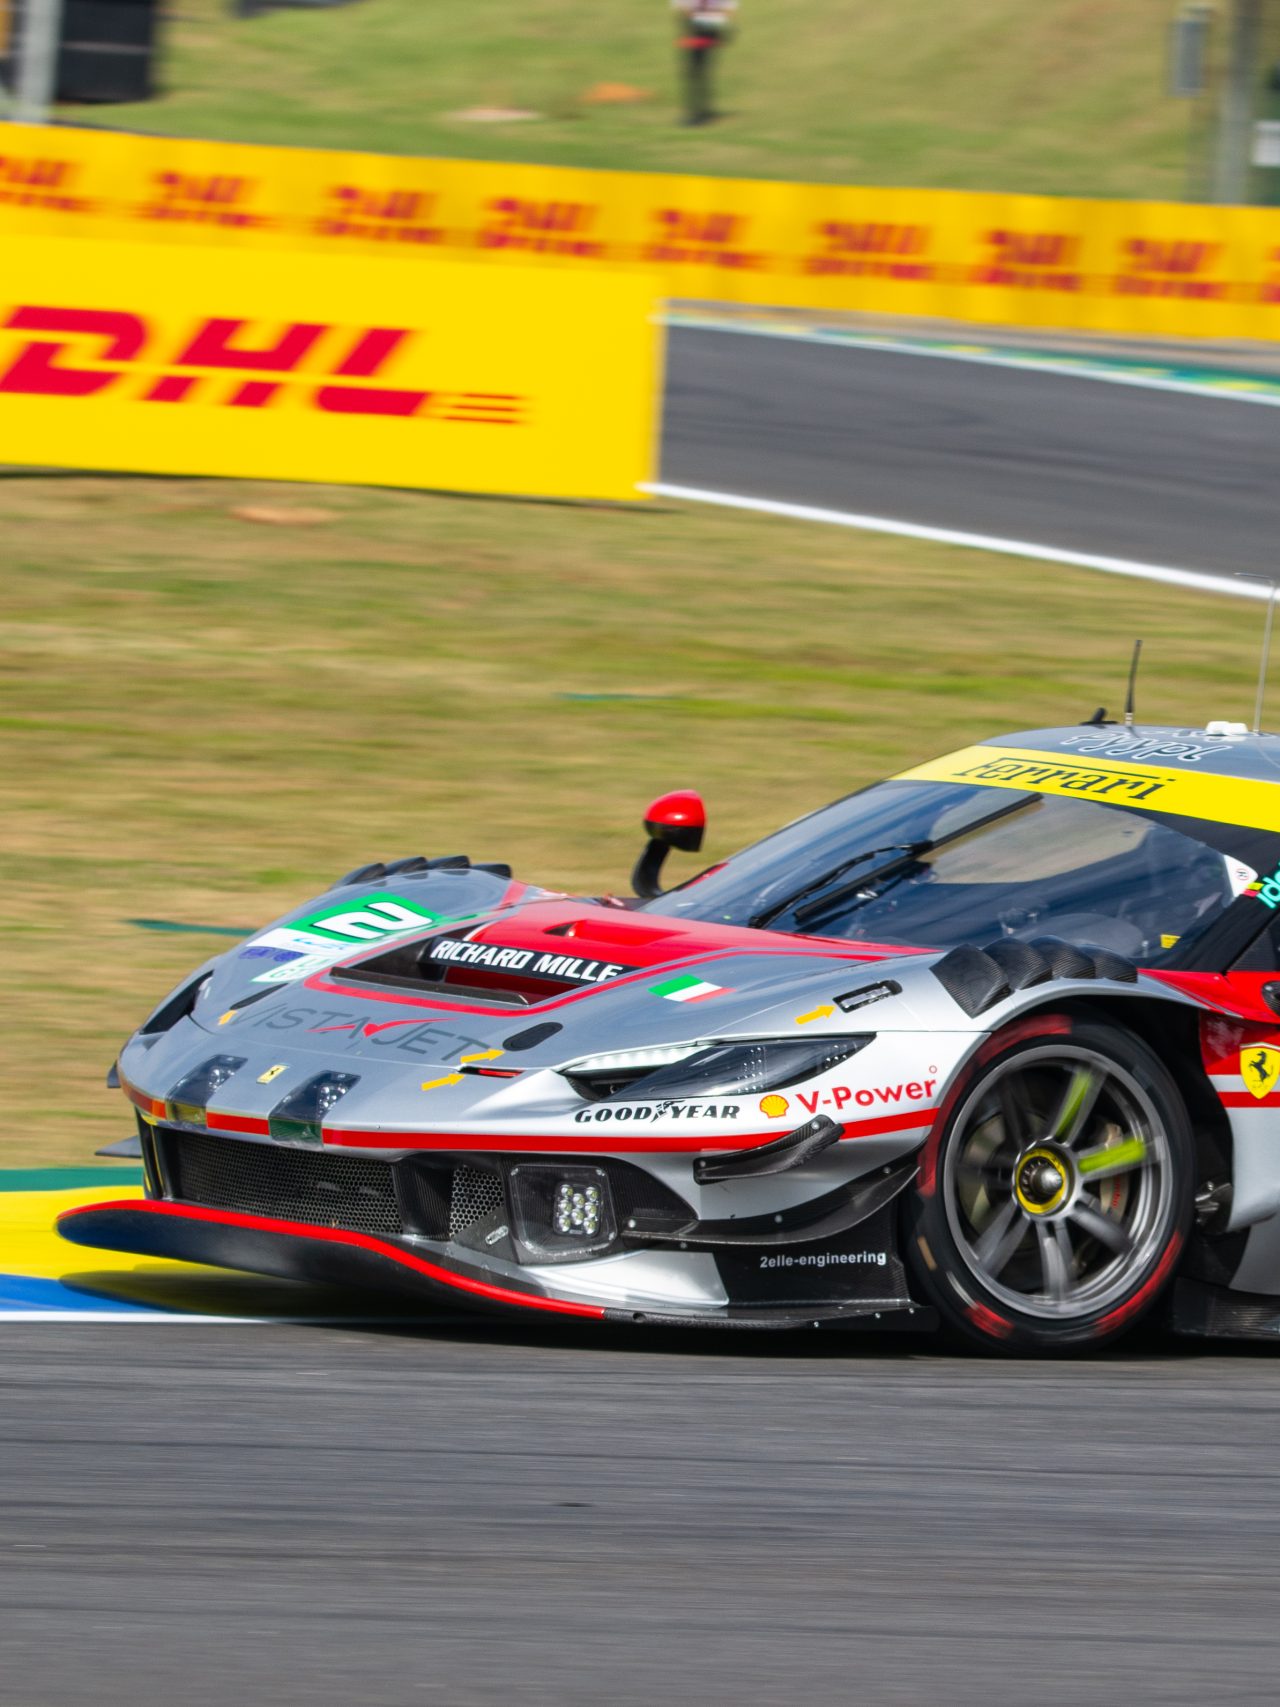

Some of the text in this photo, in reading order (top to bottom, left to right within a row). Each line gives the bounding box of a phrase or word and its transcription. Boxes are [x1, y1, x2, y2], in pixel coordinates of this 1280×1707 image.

[0, 305, 432, 418] DHL
[952, 757, 1176, 800] Ferrari
[430, 940, 624, 982] RICHARD MILLE
[575, 1102, 741, 1124] GOODYEAR
[795, 1077, 937, 1115] V-Power
[759, 1251, 887, 1268] 2elle-engineering
